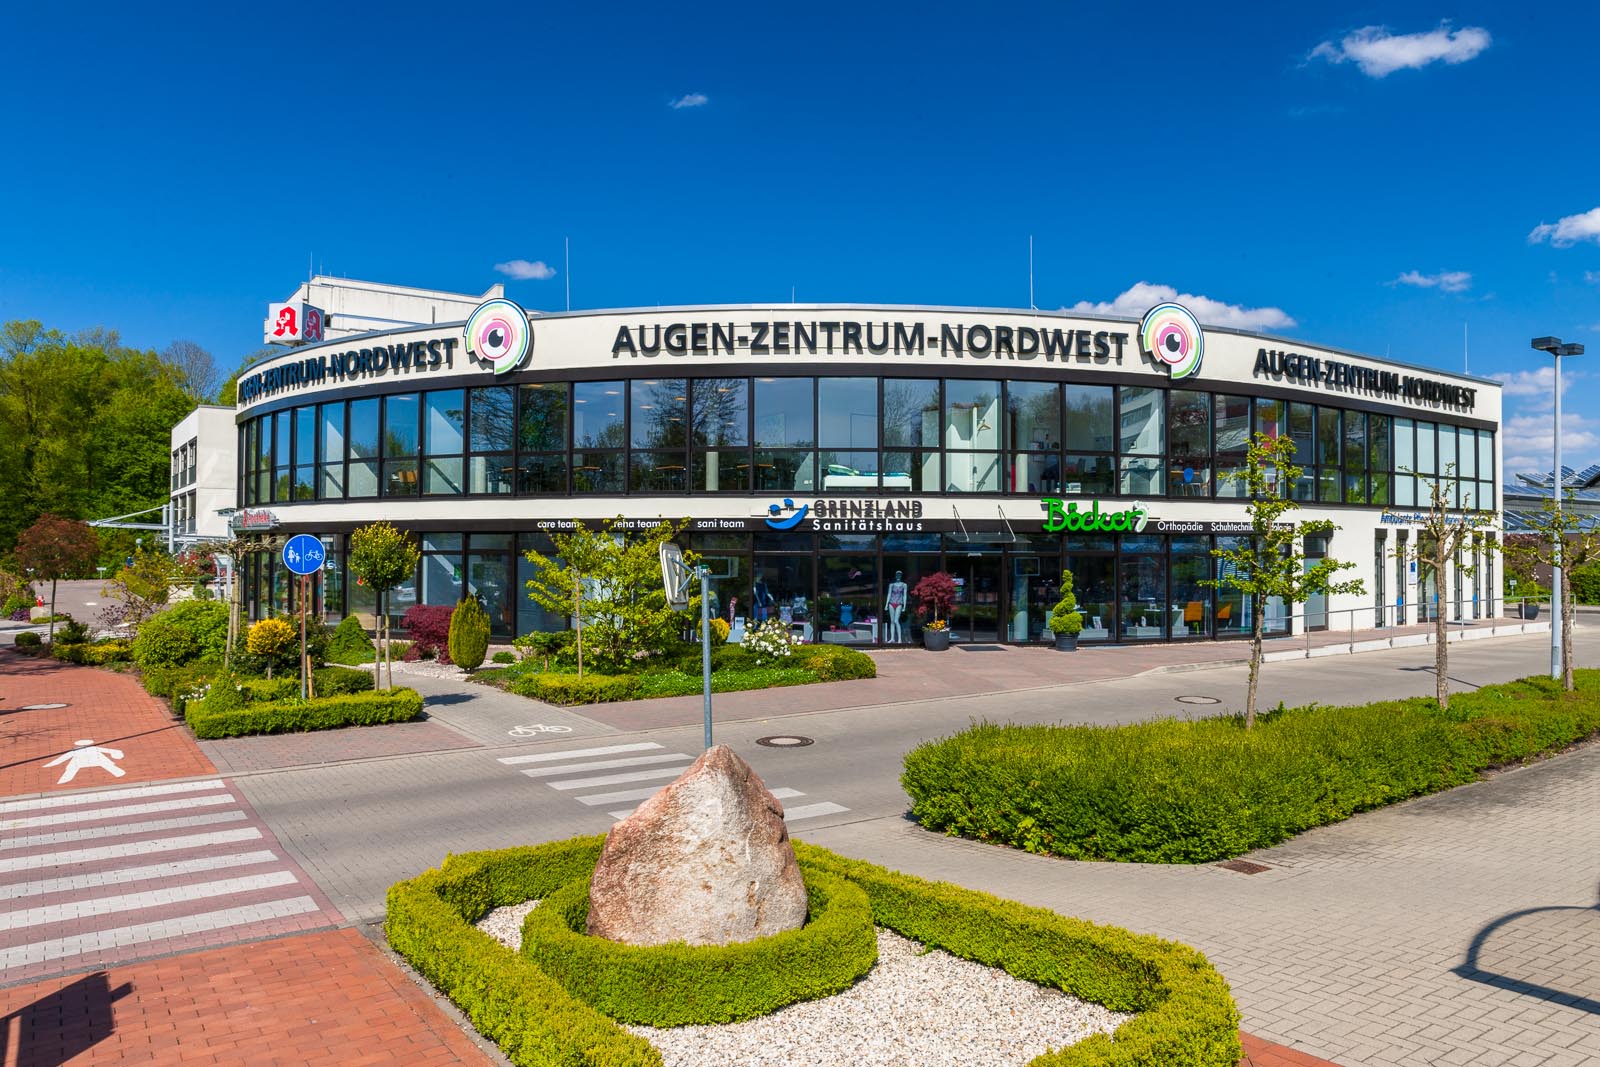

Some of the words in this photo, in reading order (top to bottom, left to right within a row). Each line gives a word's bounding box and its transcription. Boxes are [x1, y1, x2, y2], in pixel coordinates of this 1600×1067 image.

[613, 321, 1129, 360] AUGEN-ZENTRUM-NORDWEST
[1254, 348, 1477, 409] AUGEN-ZENTRUM-NORDWEST
[814, 499, 923, 518] GRENZLAND
[1041, 497, 1143, 532] Böcker
[537, 521, 556, 529] care
[558, 520, 579, 529] team
[637, 520, 661, 529] team
[697, 519, 717, 529] sani
[720, 519, 745, 529] team
[813, 519, 923, 531] Sanitätshaus
[1157, 521, 1204, 533] Orthopädie
[1211, 521, 1255, 532] Schuhtechnik
